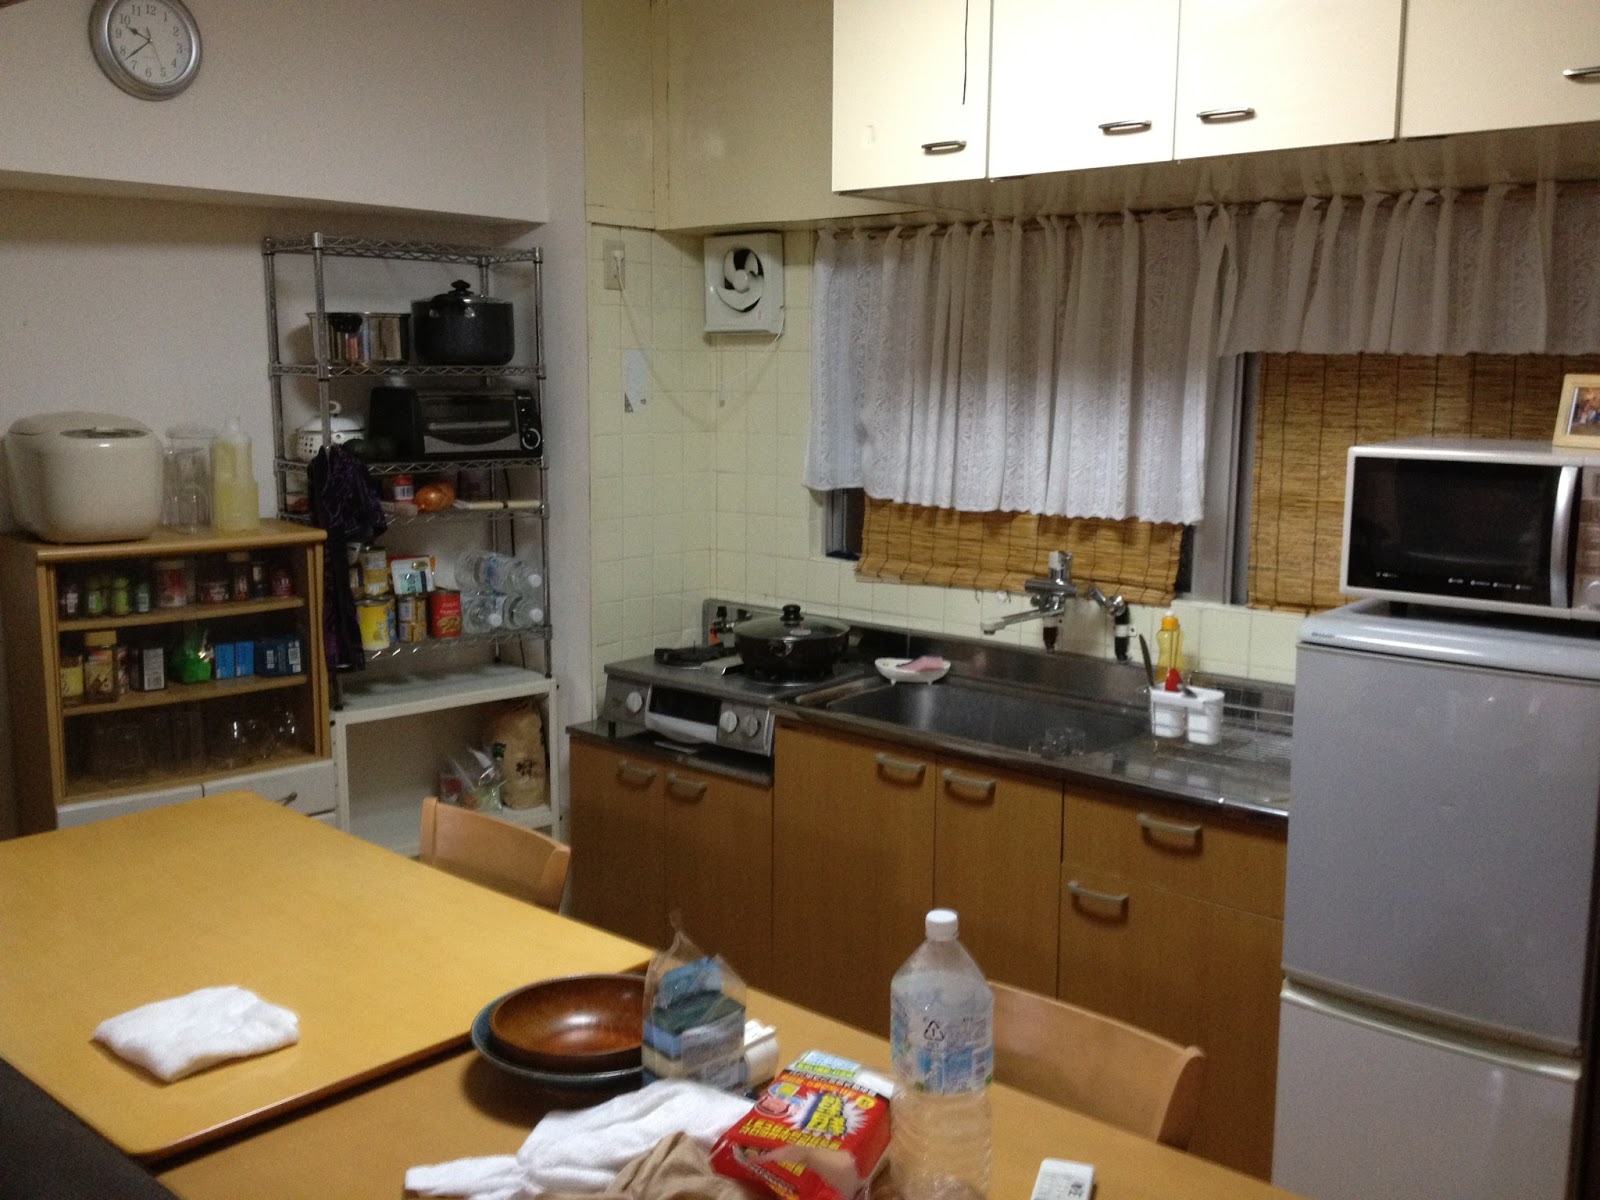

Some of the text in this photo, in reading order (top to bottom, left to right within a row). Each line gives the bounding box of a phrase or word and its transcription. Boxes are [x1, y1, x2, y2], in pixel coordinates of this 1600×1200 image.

[131, 4, 141, 17] 11
[146, 4, 157, 16] 12
[120, 13, 131, 26] 10
[163, 12, 168, 22] 1
[115, 28, 122, 38] 9
[172, 26, 179, 37] 2
[120, 45, 127, 56] 8
[177, 42, 183, 54] 3
[131, 60, 138, 70] 7
[171, 58, 177, 68] 4
[145, 67, 152, 78] 6
[160, 67, 166, 78] 5
